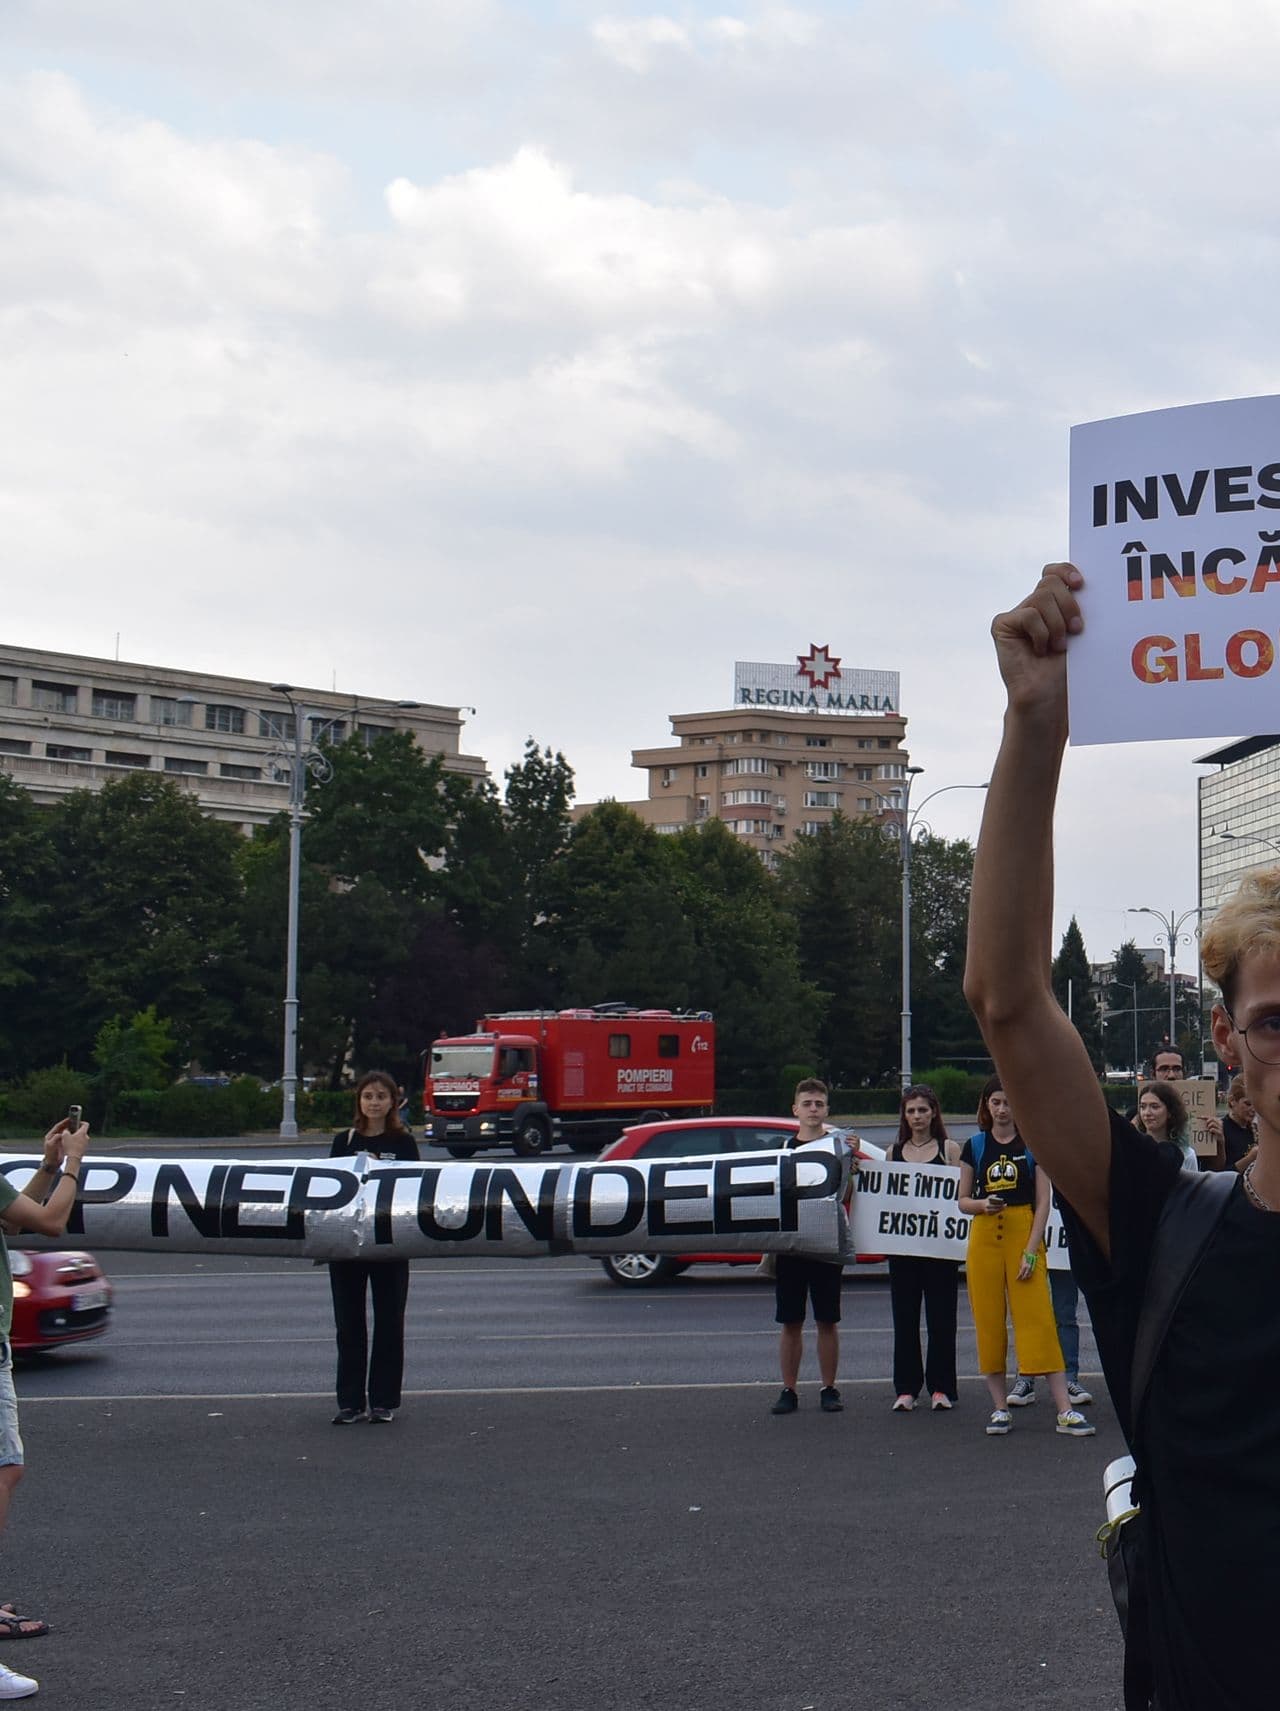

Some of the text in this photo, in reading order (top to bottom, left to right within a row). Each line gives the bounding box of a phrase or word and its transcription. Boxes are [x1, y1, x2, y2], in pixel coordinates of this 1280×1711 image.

[740, 687, 894, 711] REGINA MARIA
[617, 1069, 673, 1082] POMPIERII
[1181, 1090, 1205, 1106] GIE
[151, 1164, 561, 1245] NEPTUN
[573, 1151, 842, 1237] DEEP
[857, 1170, 960, 1201] NU NE ÎNTO
[879, 1210, 939, 1238] EXISTĂ
